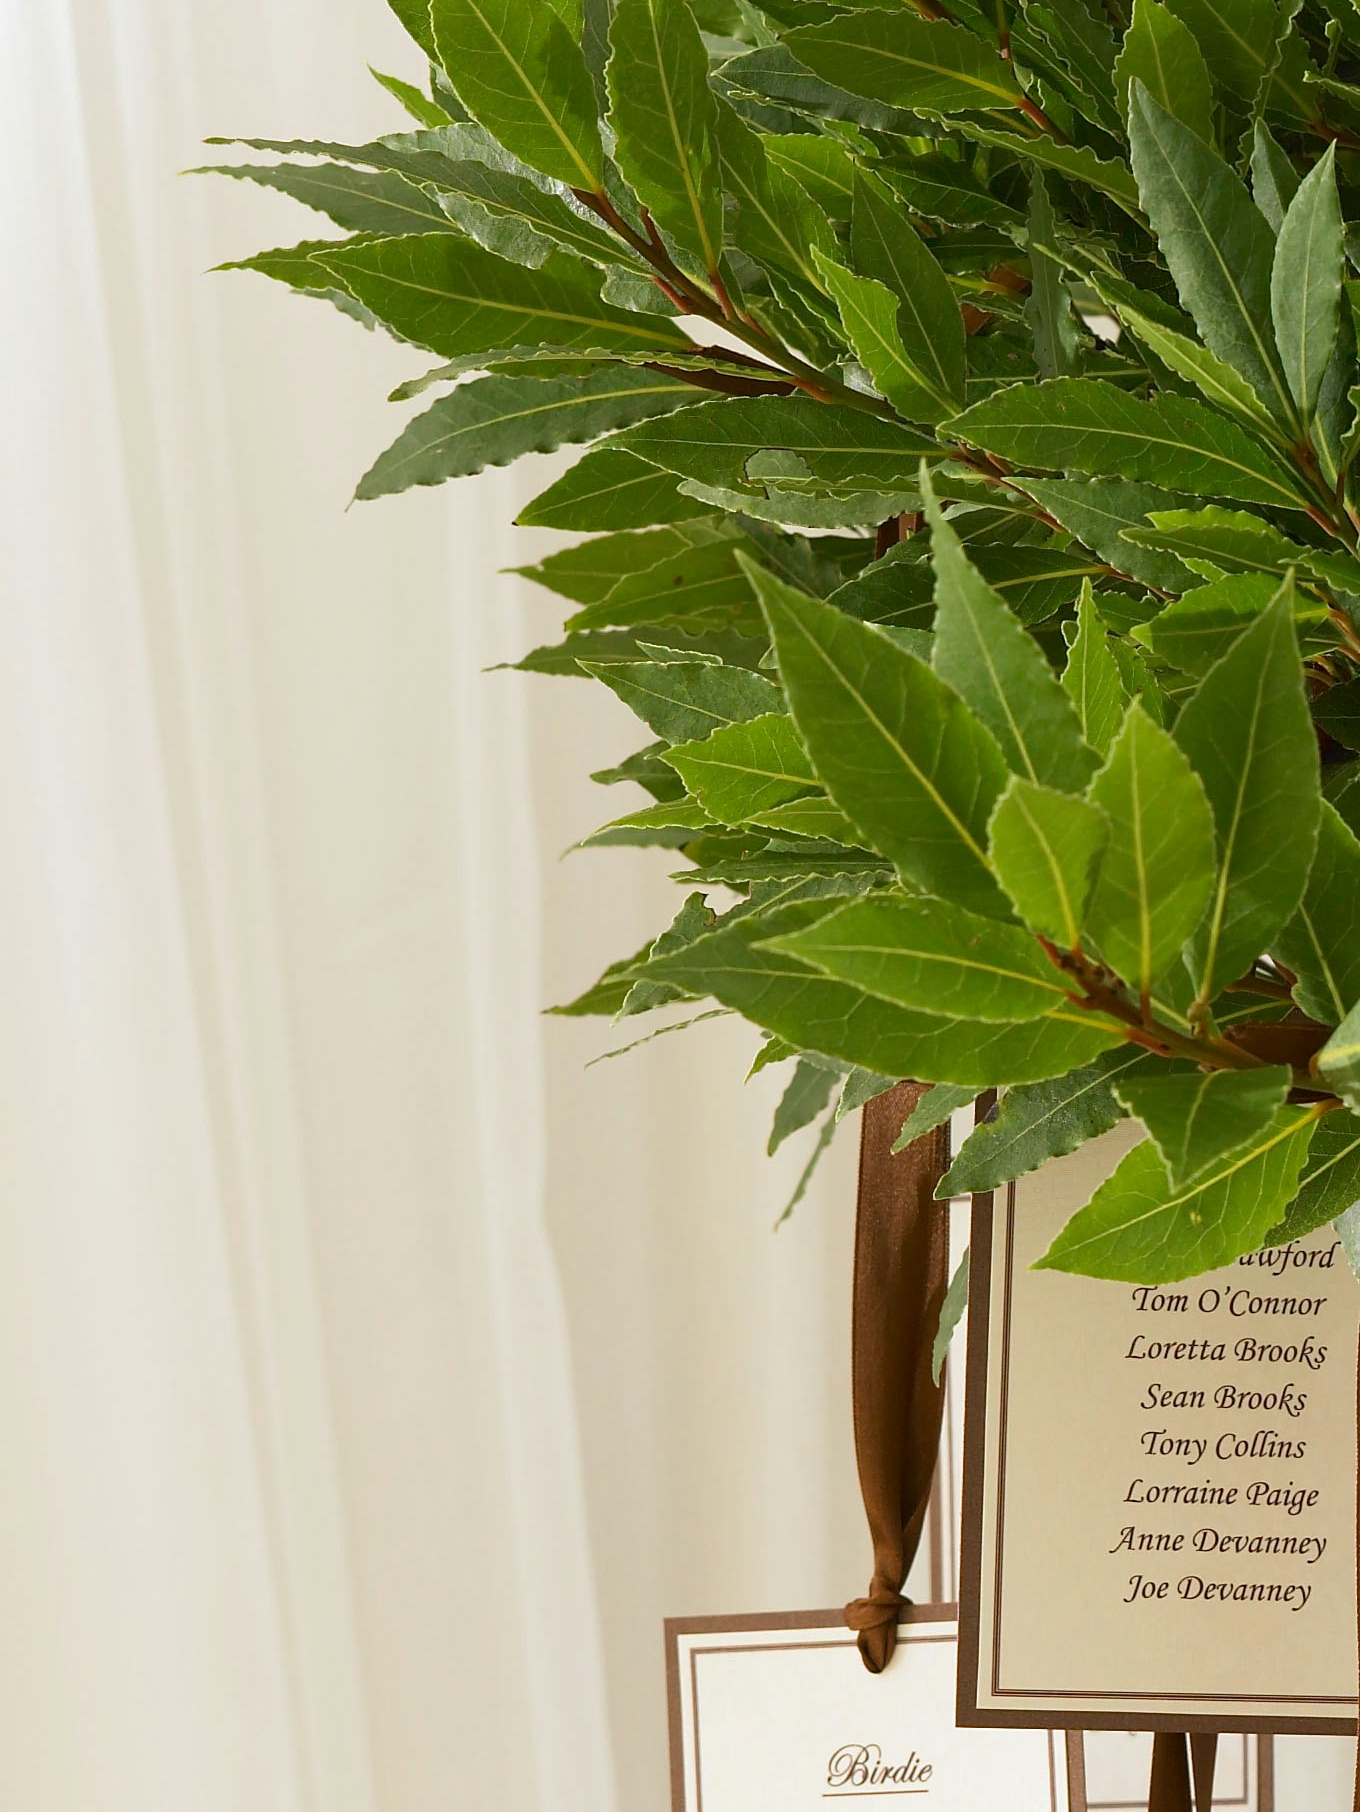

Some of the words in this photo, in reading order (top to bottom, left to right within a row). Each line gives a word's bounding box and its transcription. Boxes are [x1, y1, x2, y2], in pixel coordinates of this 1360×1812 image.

[1238, 1239, 1342, 1277] awford
[1132, 1285, 1189, 1313] Tom
[1198, 1285, 1328, 1317] O'Connor
[1124, 1334, 1226, 1361] Loretta
[1234, 1335, 1328, 1370] Brooks
[1140, 1383, 1205, 1410] Sean
[1213, 1382, 1308, 1418] Brooks
[1140, 1428, 1208, 1466] Tony
[1215, 1430, 1307, 1460] Collins
[1123, 1478, 1238, 1505] Lorraine
[1246, 1481, 1320, 1516] Paige
[1108, 1526, 1185, 1554] Anne
[1192, 1528, 1327, 1564] Devanney
[1123, 1575, 1170, 1603] Joe
[1177, 1575, 1312, 1612] Devanney
[826, 1743, 933, 1788] Birdie
